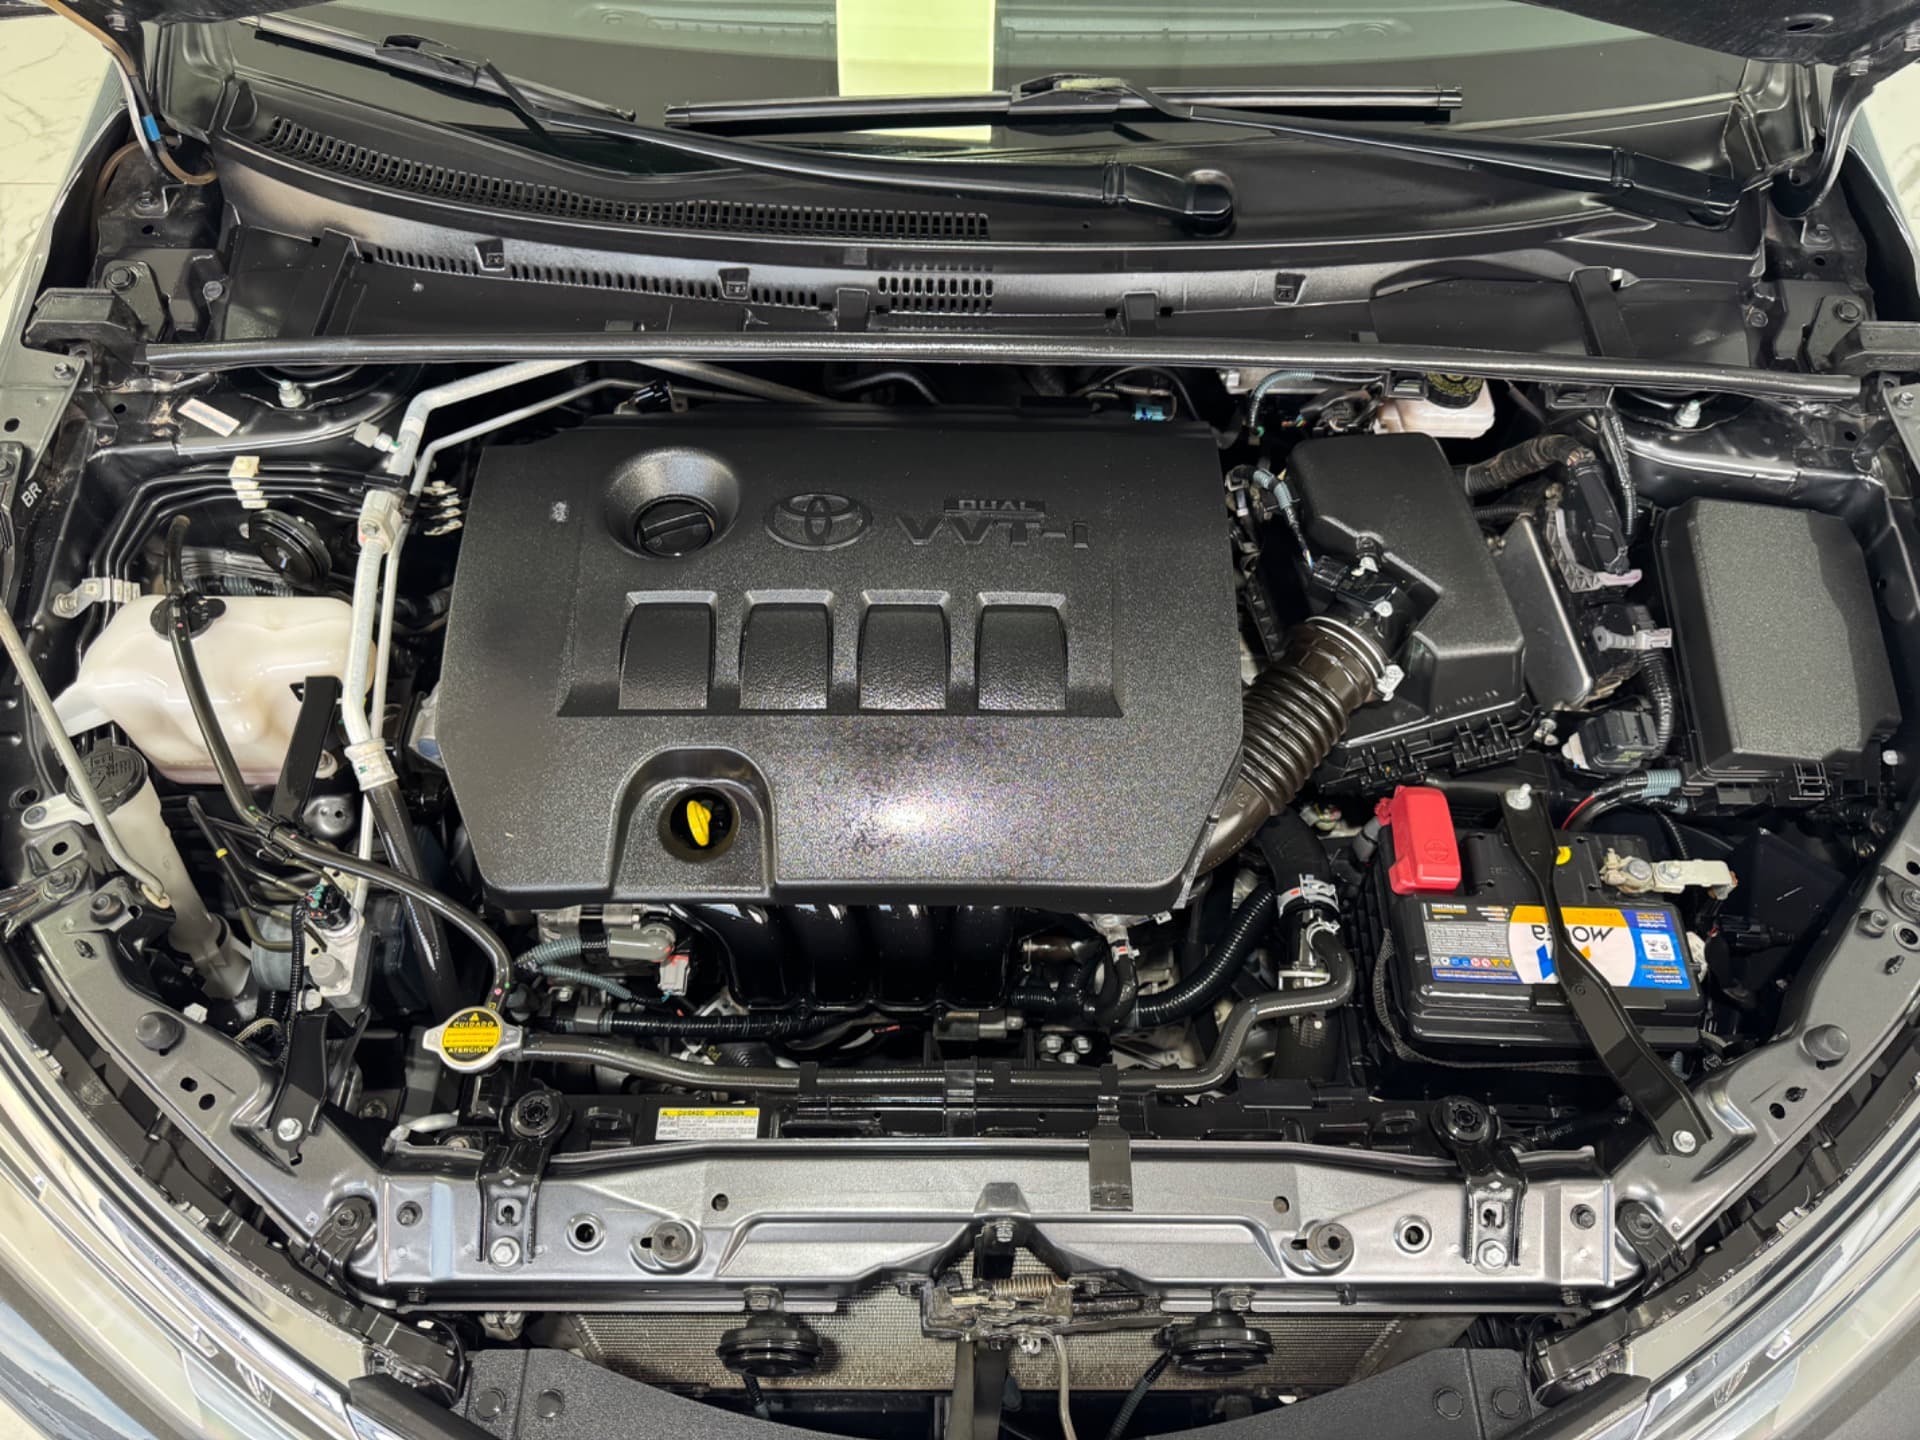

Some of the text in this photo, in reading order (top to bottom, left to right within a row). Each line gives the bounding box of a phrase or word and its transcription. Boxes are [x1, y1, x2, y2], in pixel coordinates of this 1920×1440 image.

[21, 482, 42, 508] BR
[958, 499, 1036, 511] DUAL
[453, 1020, 495, 1028] CUIDADO
